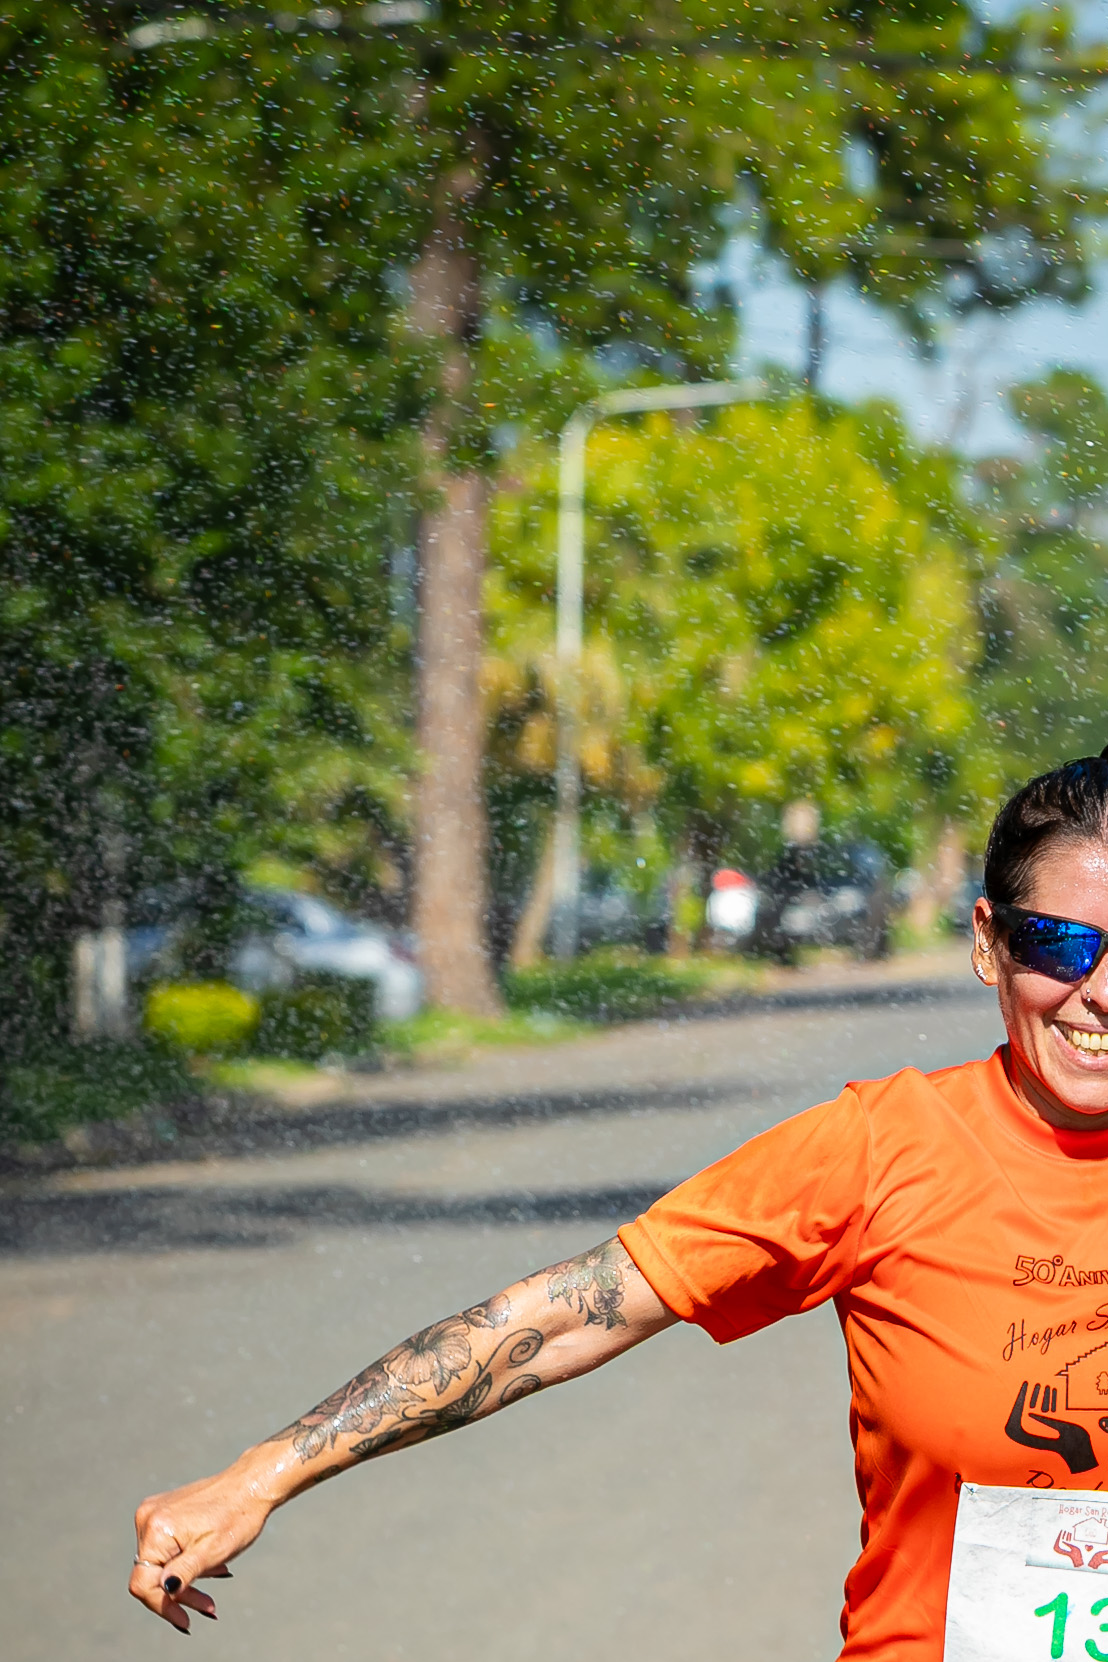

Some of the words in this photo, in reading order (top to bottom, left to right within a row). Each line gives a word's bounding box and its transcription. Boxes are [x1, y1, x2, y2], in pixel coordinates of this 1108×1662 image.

[1002, 1318, 1077, 1362] Hogar
[1058, 1503, 1083, 1516] Hogar
[1085, 1505, 1100, 1517] San
